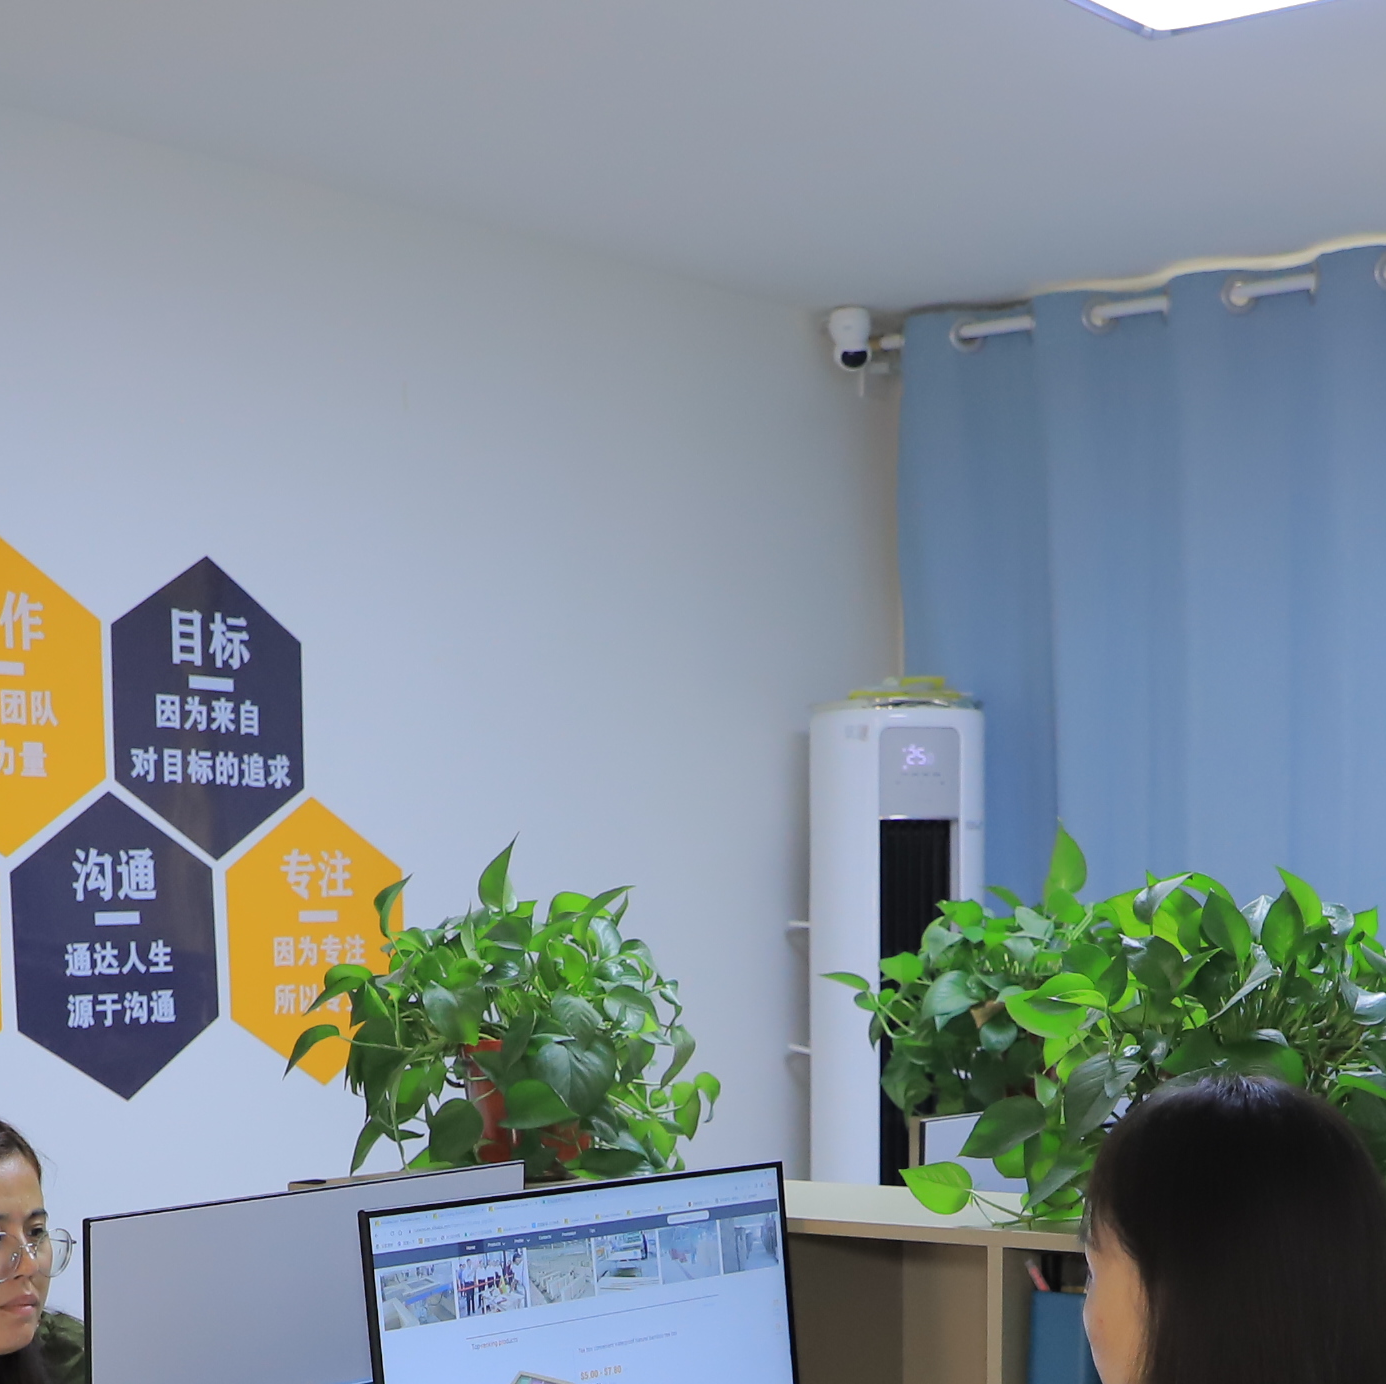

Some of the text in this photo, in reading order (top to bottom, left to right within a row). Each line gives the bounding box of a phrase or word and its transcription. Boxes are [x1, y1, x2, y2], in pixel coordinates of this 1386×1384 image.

[170, 608, 251, 671] 目标
[155, 694, 261, 737] 因为来自
[130, 746, 292, 790] 对目标的追求
[70, 846, 157, 903] 沟通
[280, 848, 354, 900] 专注
[64, 939, 174, 977] 通达人生
[273, 934, 366, 967] 因为专注
[67, 988, 177, 1030] 源于沟通
[274, 983, 353, 1015] 所以
